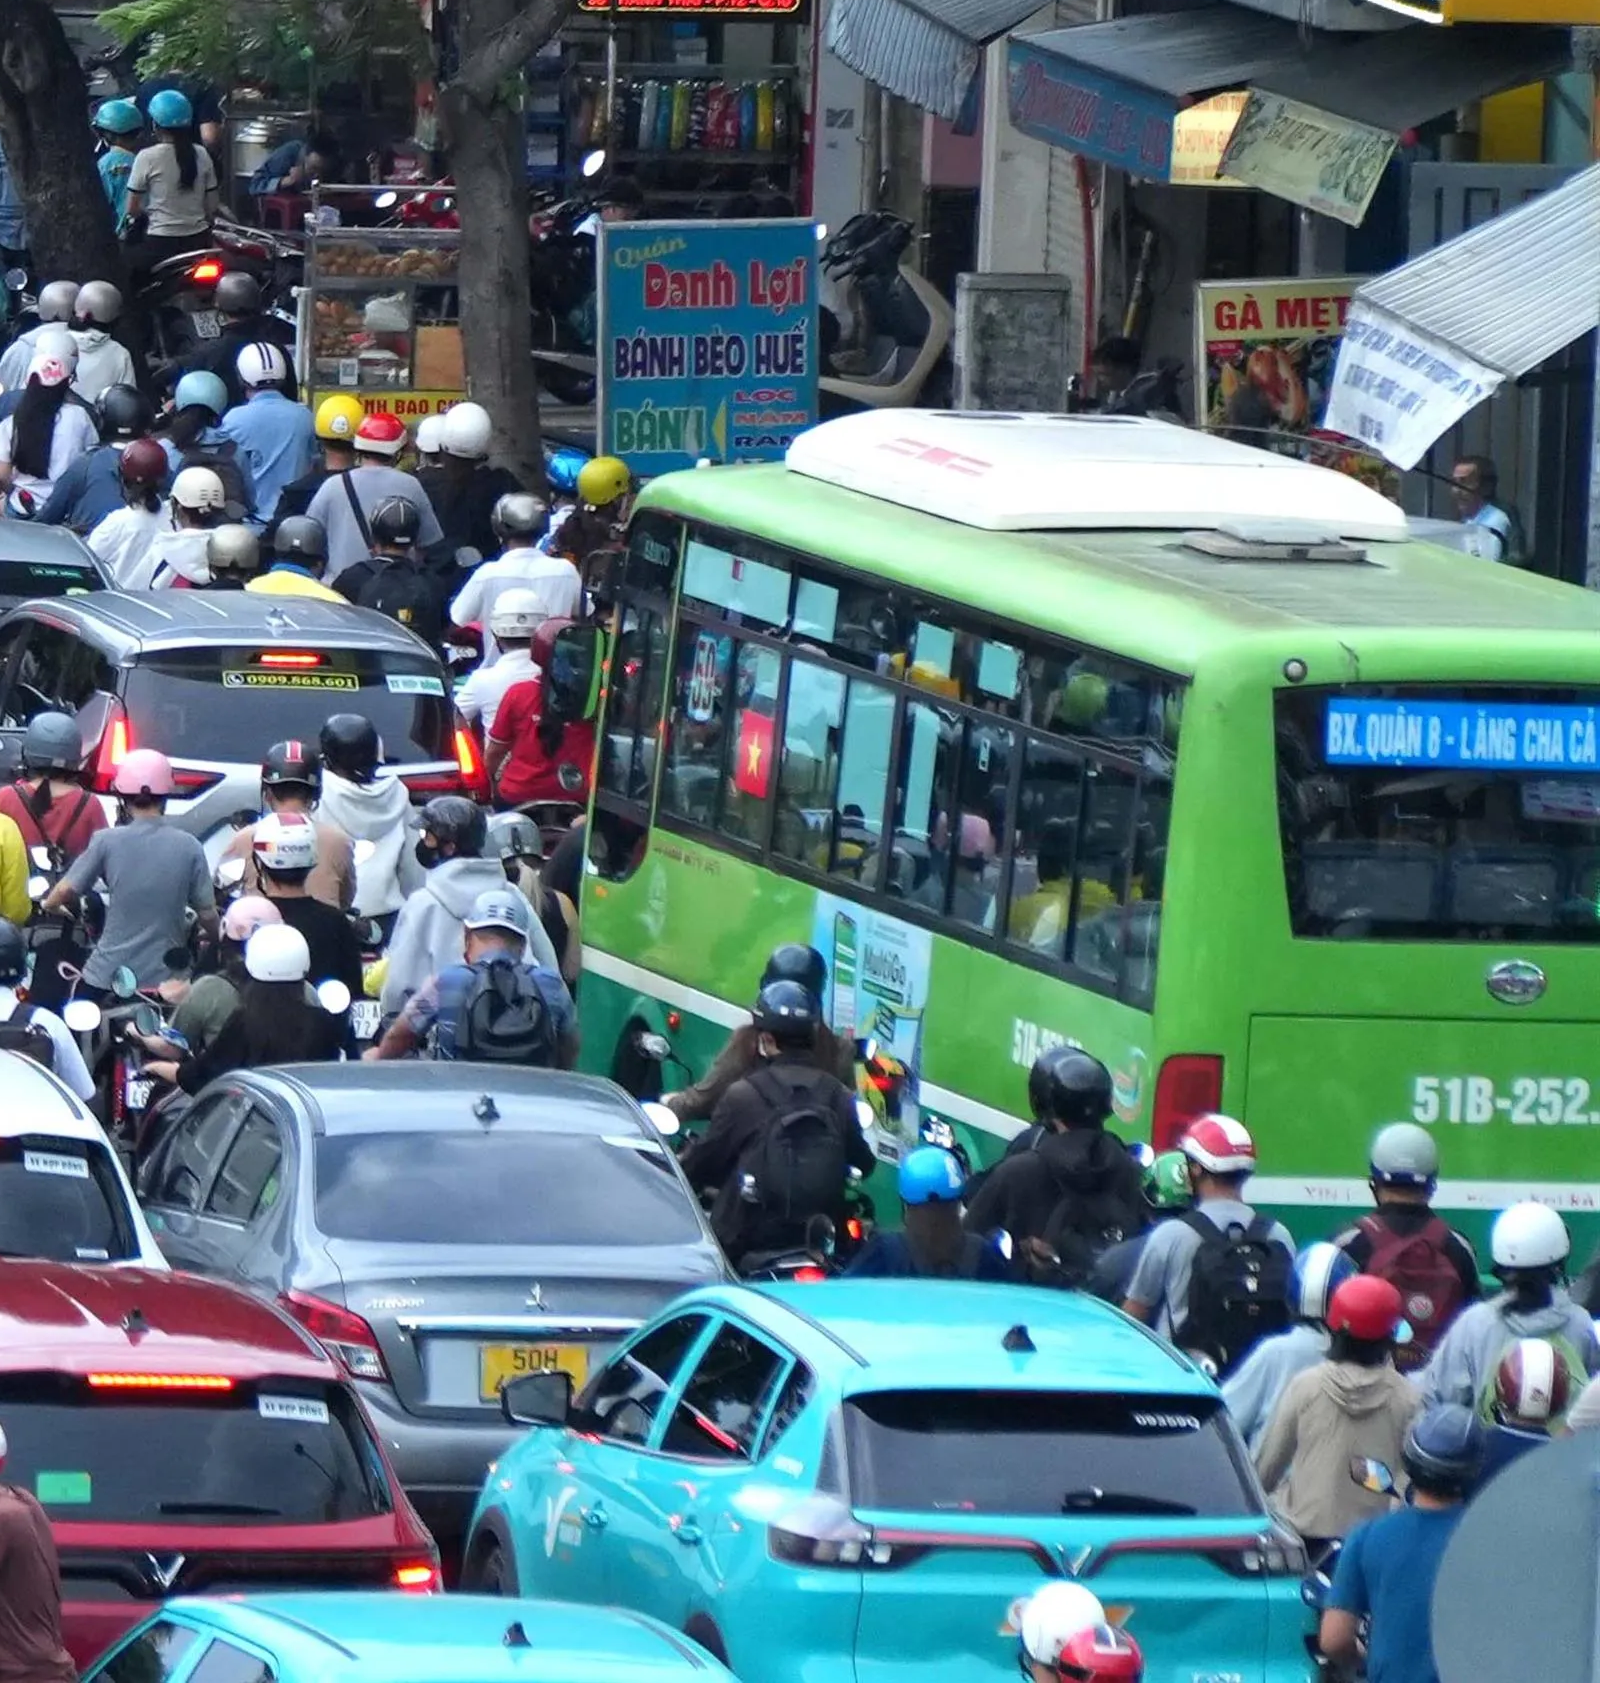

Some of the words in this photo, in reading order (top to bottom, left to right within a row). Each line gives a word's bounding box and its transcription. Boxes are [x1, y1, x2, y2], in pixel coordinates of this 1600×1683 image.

[614, 235, 688, 268] Quán
[644, 259, 737, 310] Danh
[1213, 293, 1264, 332] GÀ
[1275, 296, 1351, 335] MẸT
[613, 324, 689, 381] BÁNH
[693, 322, 748, 379] BÈO
[753, 317, 809, 378] HUẾ
[1327, 710, 1363, 757] BX.
[1365, 705, 1424, 767] QUẬN
[1427, 715, 1442, 760] 8
[1459, 708, 1518, 762] LĂNG
[1522, 717, 1566, 764] CHA
[1568, 706, 1598, 765] CẢ
